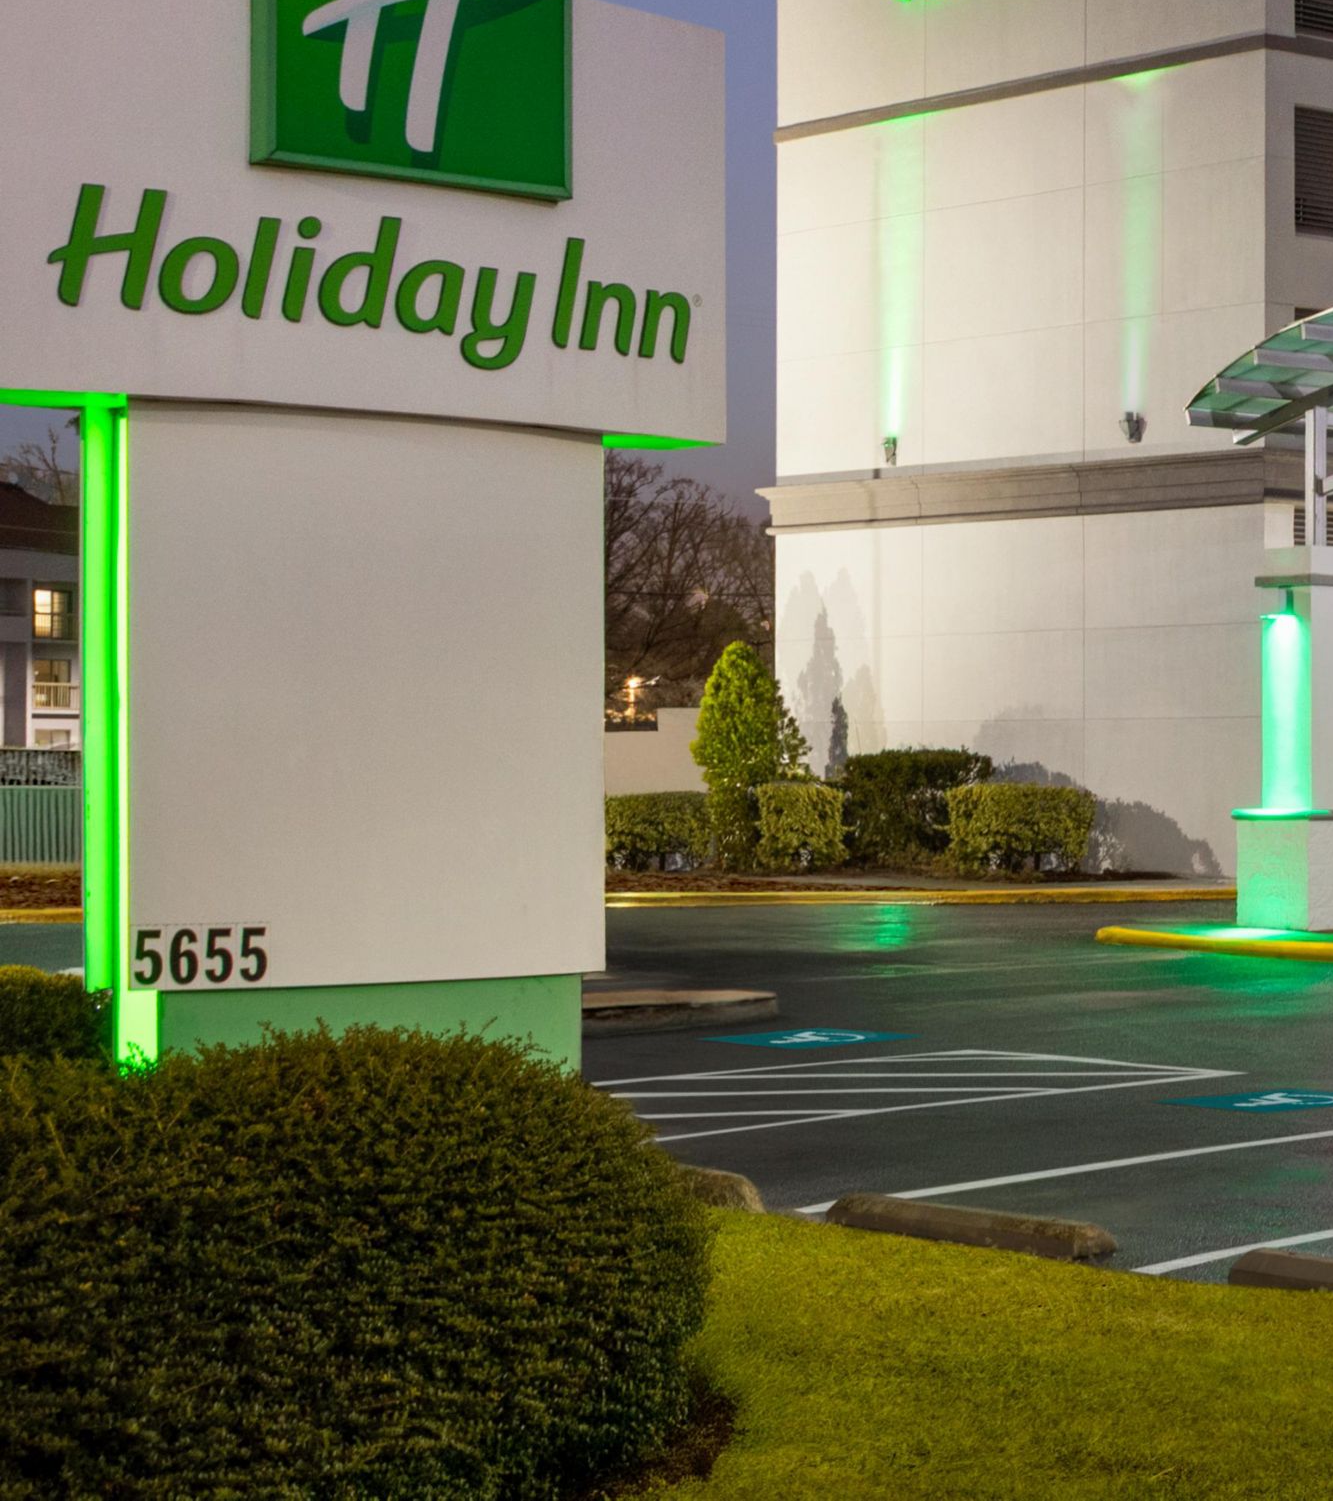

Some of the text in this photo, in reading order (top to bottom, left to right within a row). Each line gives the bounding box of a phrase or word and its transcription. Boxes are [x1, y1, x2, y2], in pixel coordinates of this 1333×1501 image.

[47, 183, 692, 371] Holiday Inn
[133, 926, 268, 986] 5655
